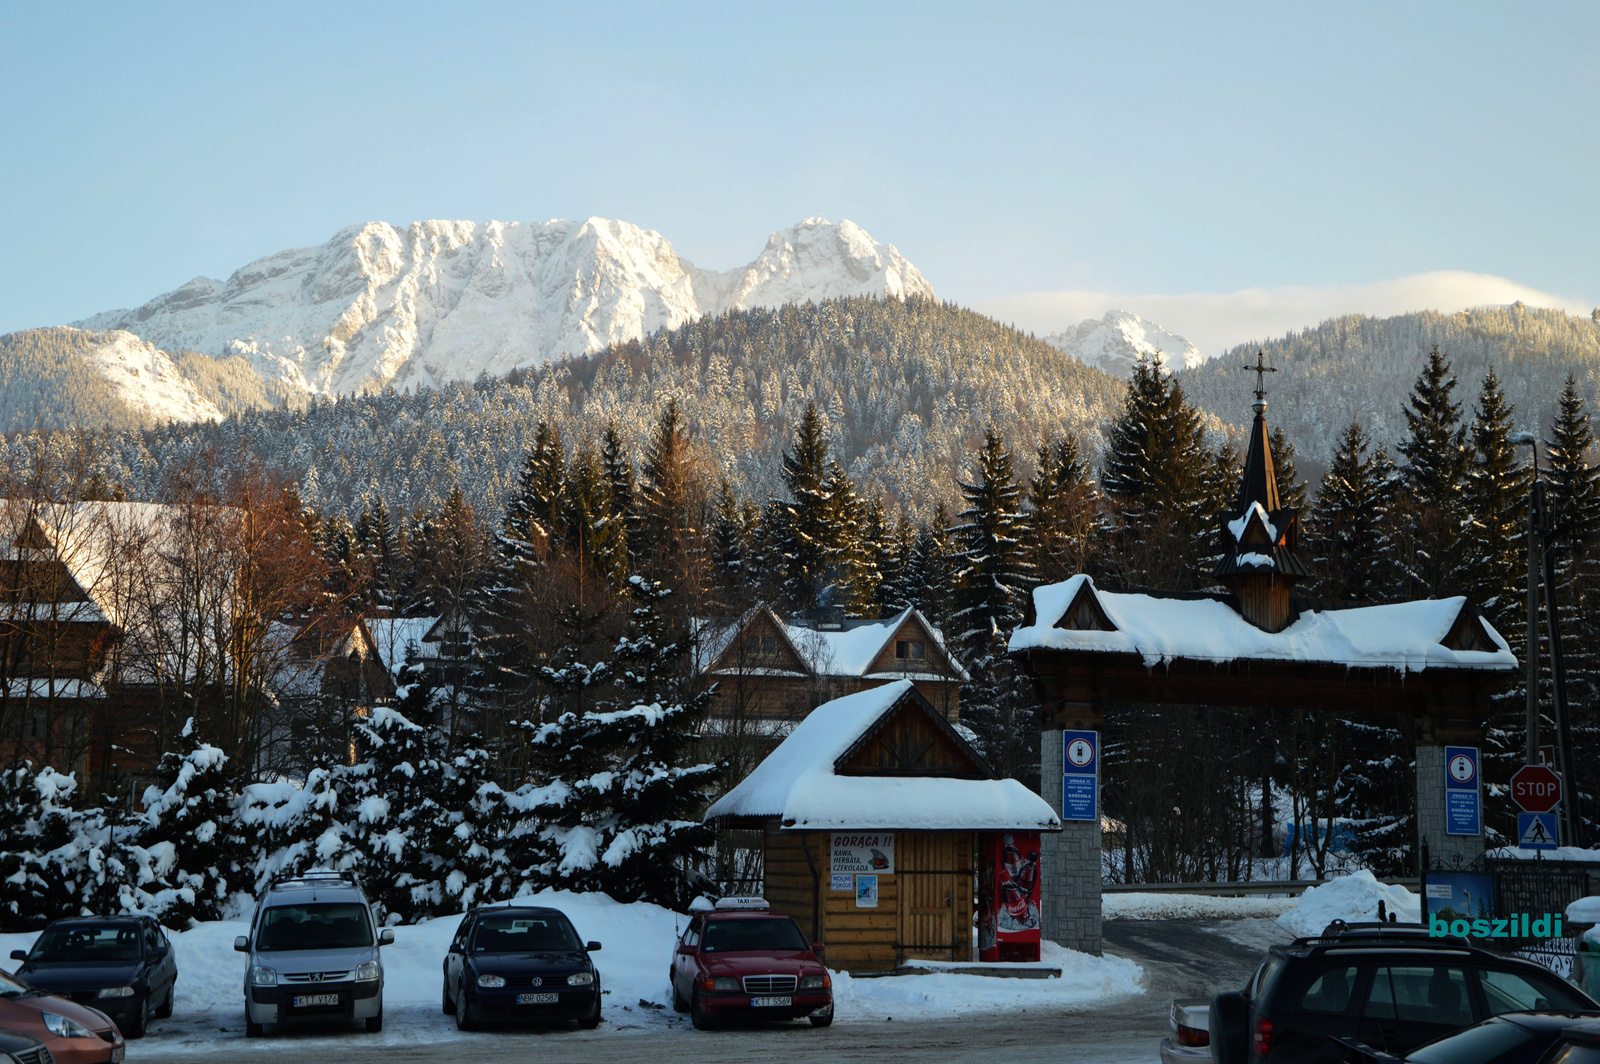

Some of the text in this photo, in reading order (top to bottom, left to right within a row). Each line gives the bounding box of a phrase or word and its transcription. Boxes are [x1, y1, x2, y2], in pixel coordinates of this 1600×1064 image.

[1517, 782, 1557, 797] STOP
[834, 836, 893, 848] GORĄCA !!
[833, 857, 862, 865] HERBATA,
[298, 995, 338, 1005] KTT V176
[520, 993, 558, 1002] NBR 02587
[755, 997, 791, 1006] KTT S569
